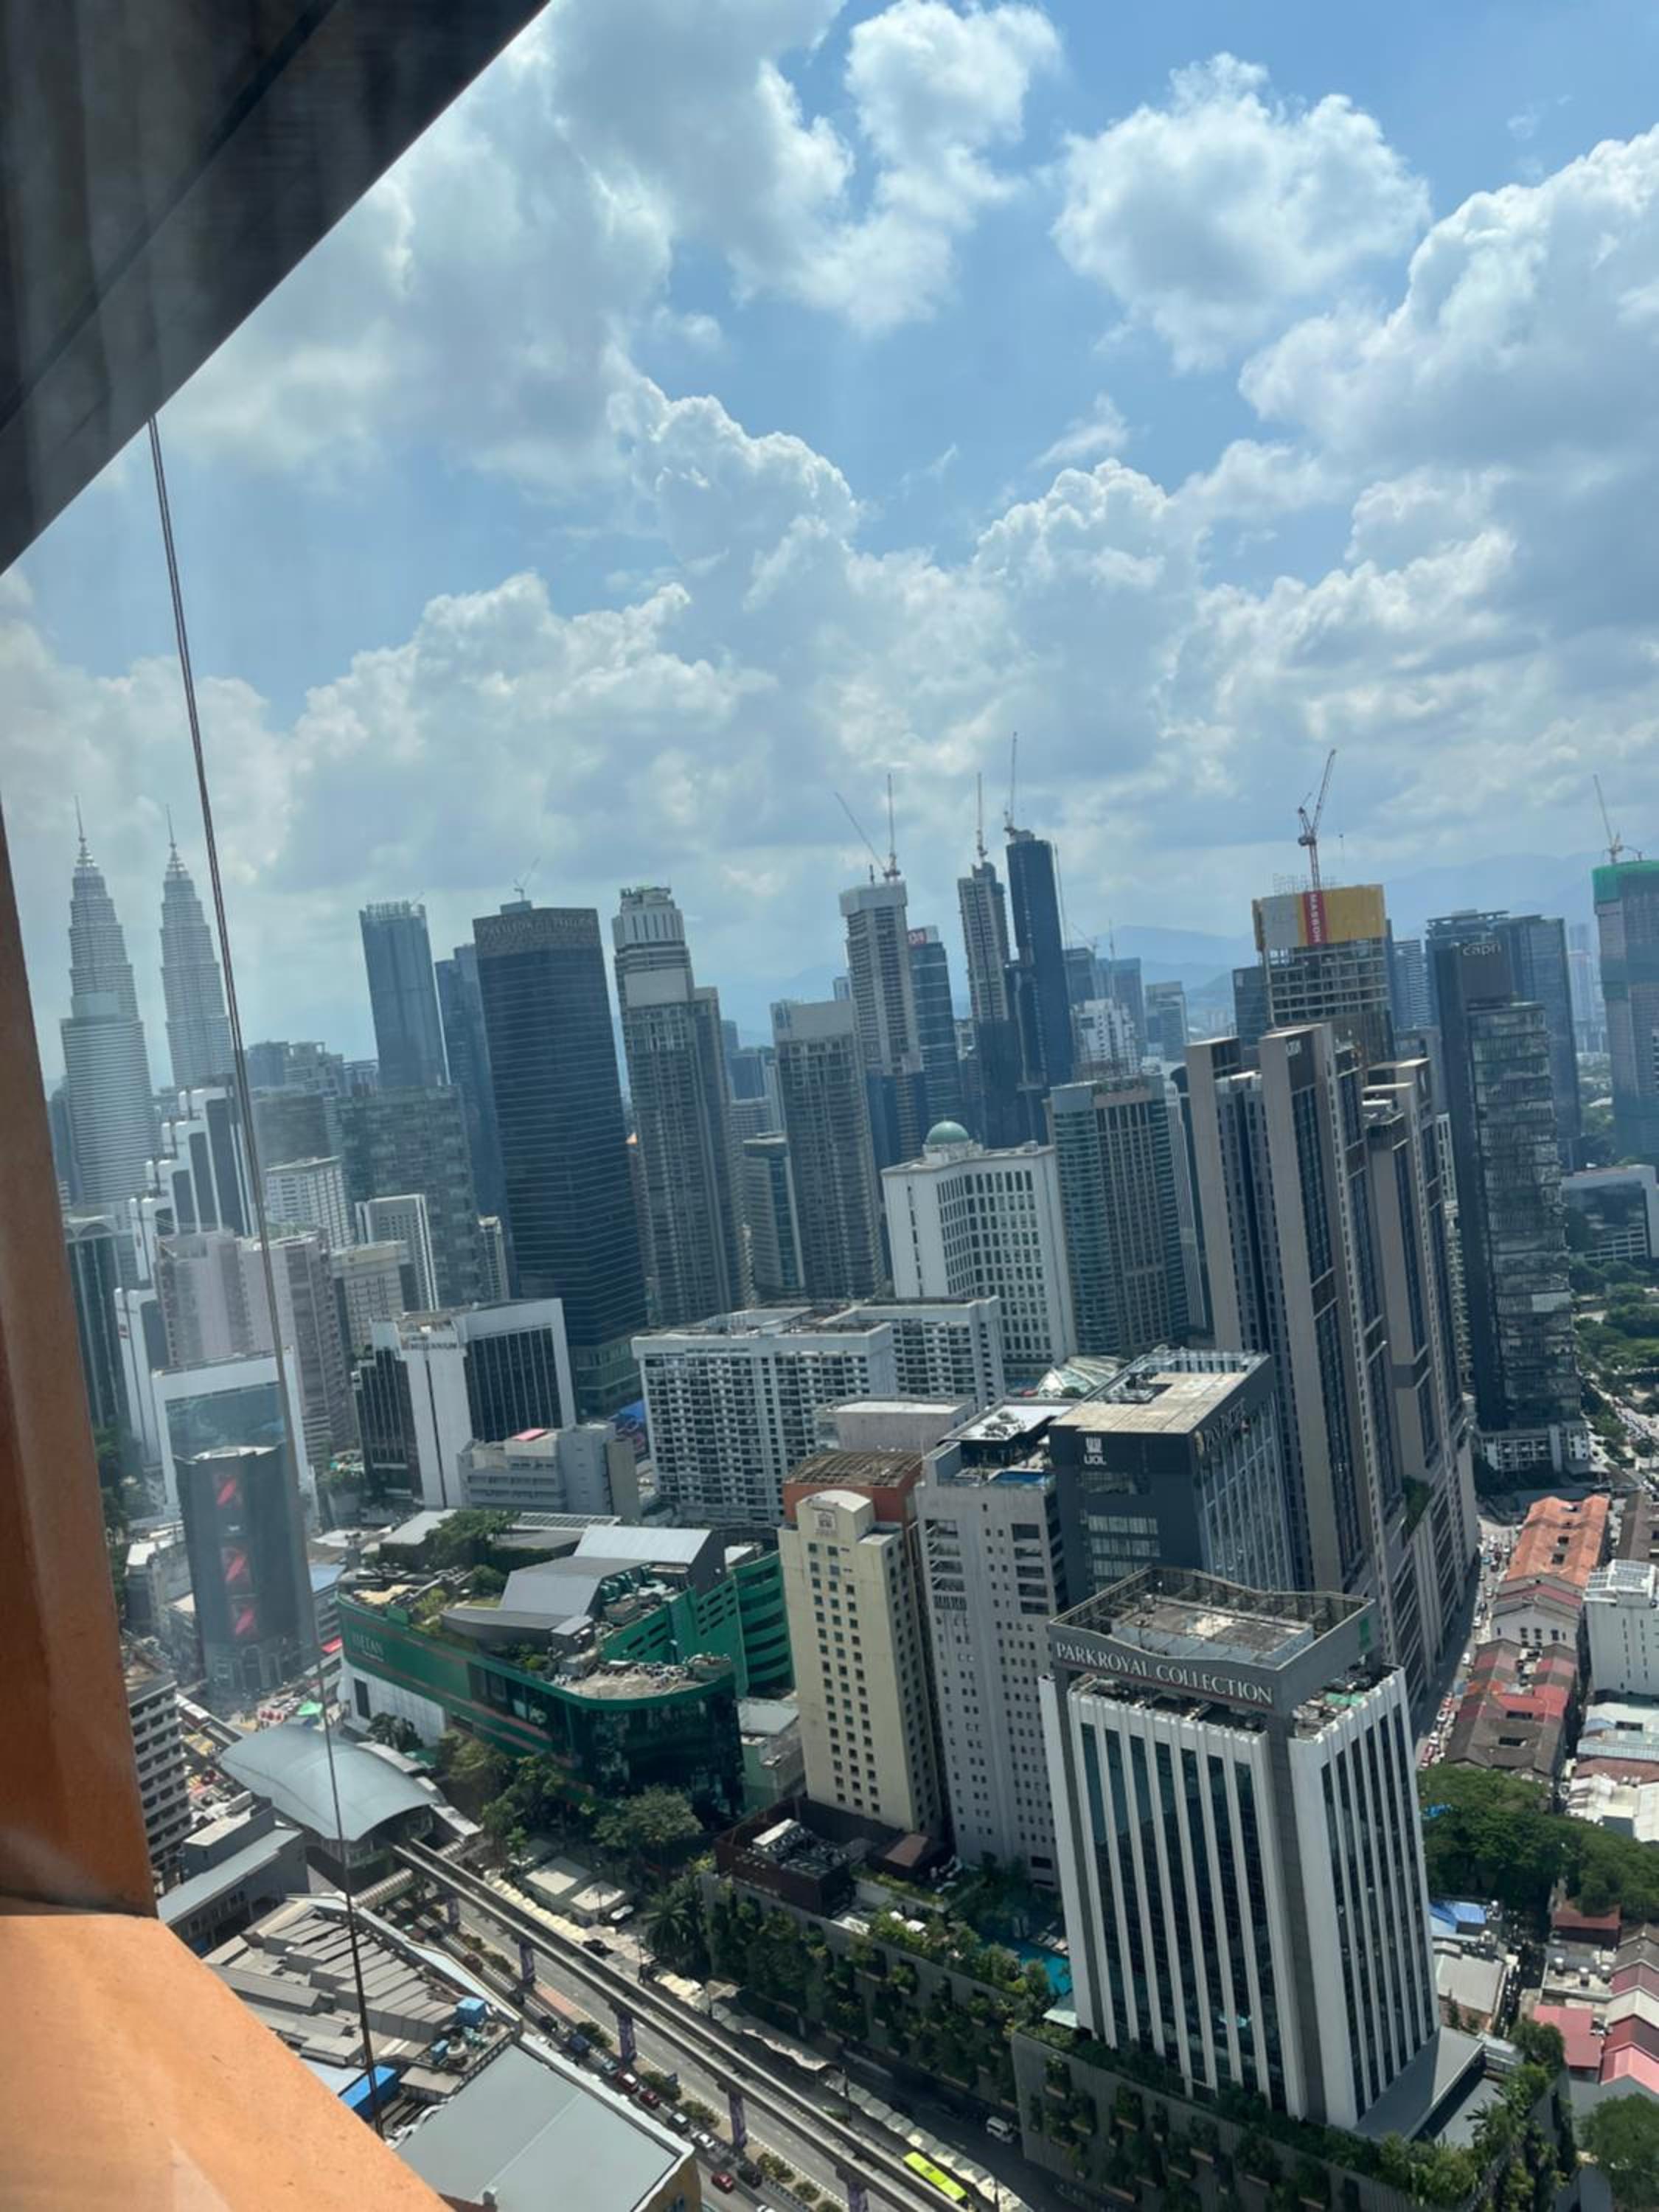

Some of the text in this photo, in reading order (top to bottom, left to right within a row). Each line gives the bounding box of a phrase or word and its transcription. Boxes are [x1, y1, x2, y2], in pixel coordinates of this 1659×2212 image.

[1084, 1453, 1107, 1465] UOL
[1056, 1641, 1273, 1704] PARKROYAL COLLECTION
